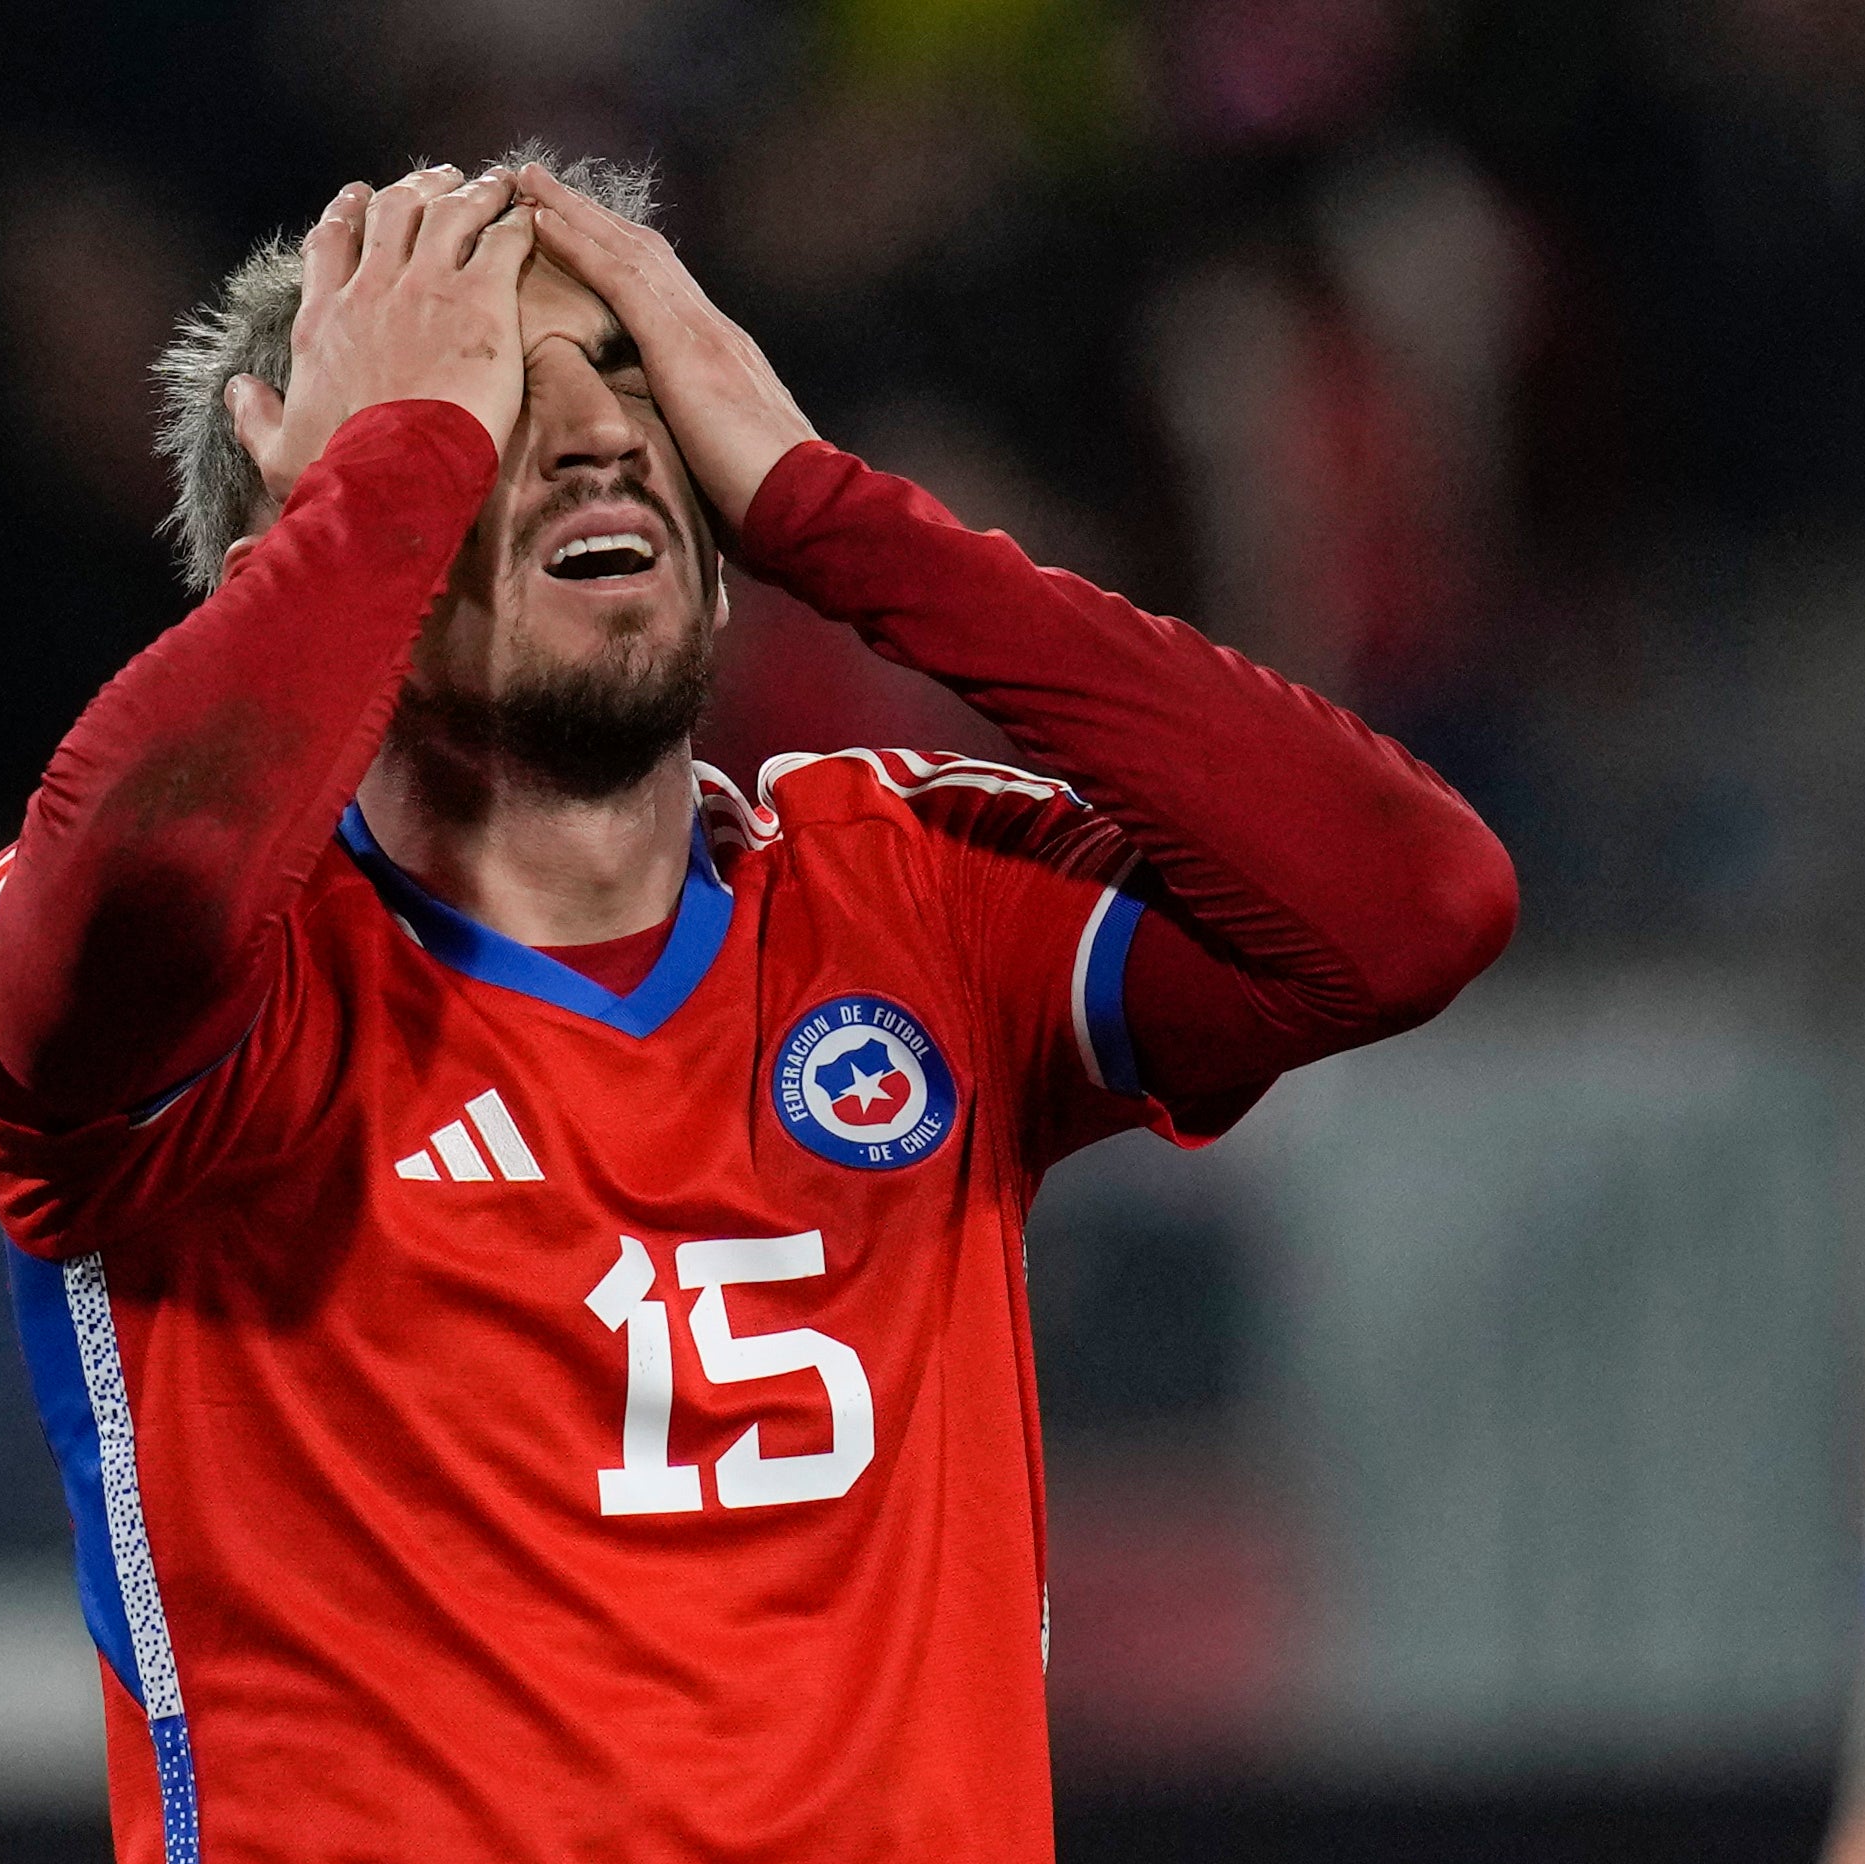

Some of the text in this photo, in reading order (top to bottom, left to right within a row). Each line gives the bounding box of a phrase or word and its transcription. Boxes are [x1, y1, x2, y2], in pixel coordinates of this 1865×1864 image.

[781, 1005, 930, 1123] FEDERACION DE FUTBOL
[868, 1117, 943, 1162] DE CHILE
[583, 1229, 875, 1516] 15
